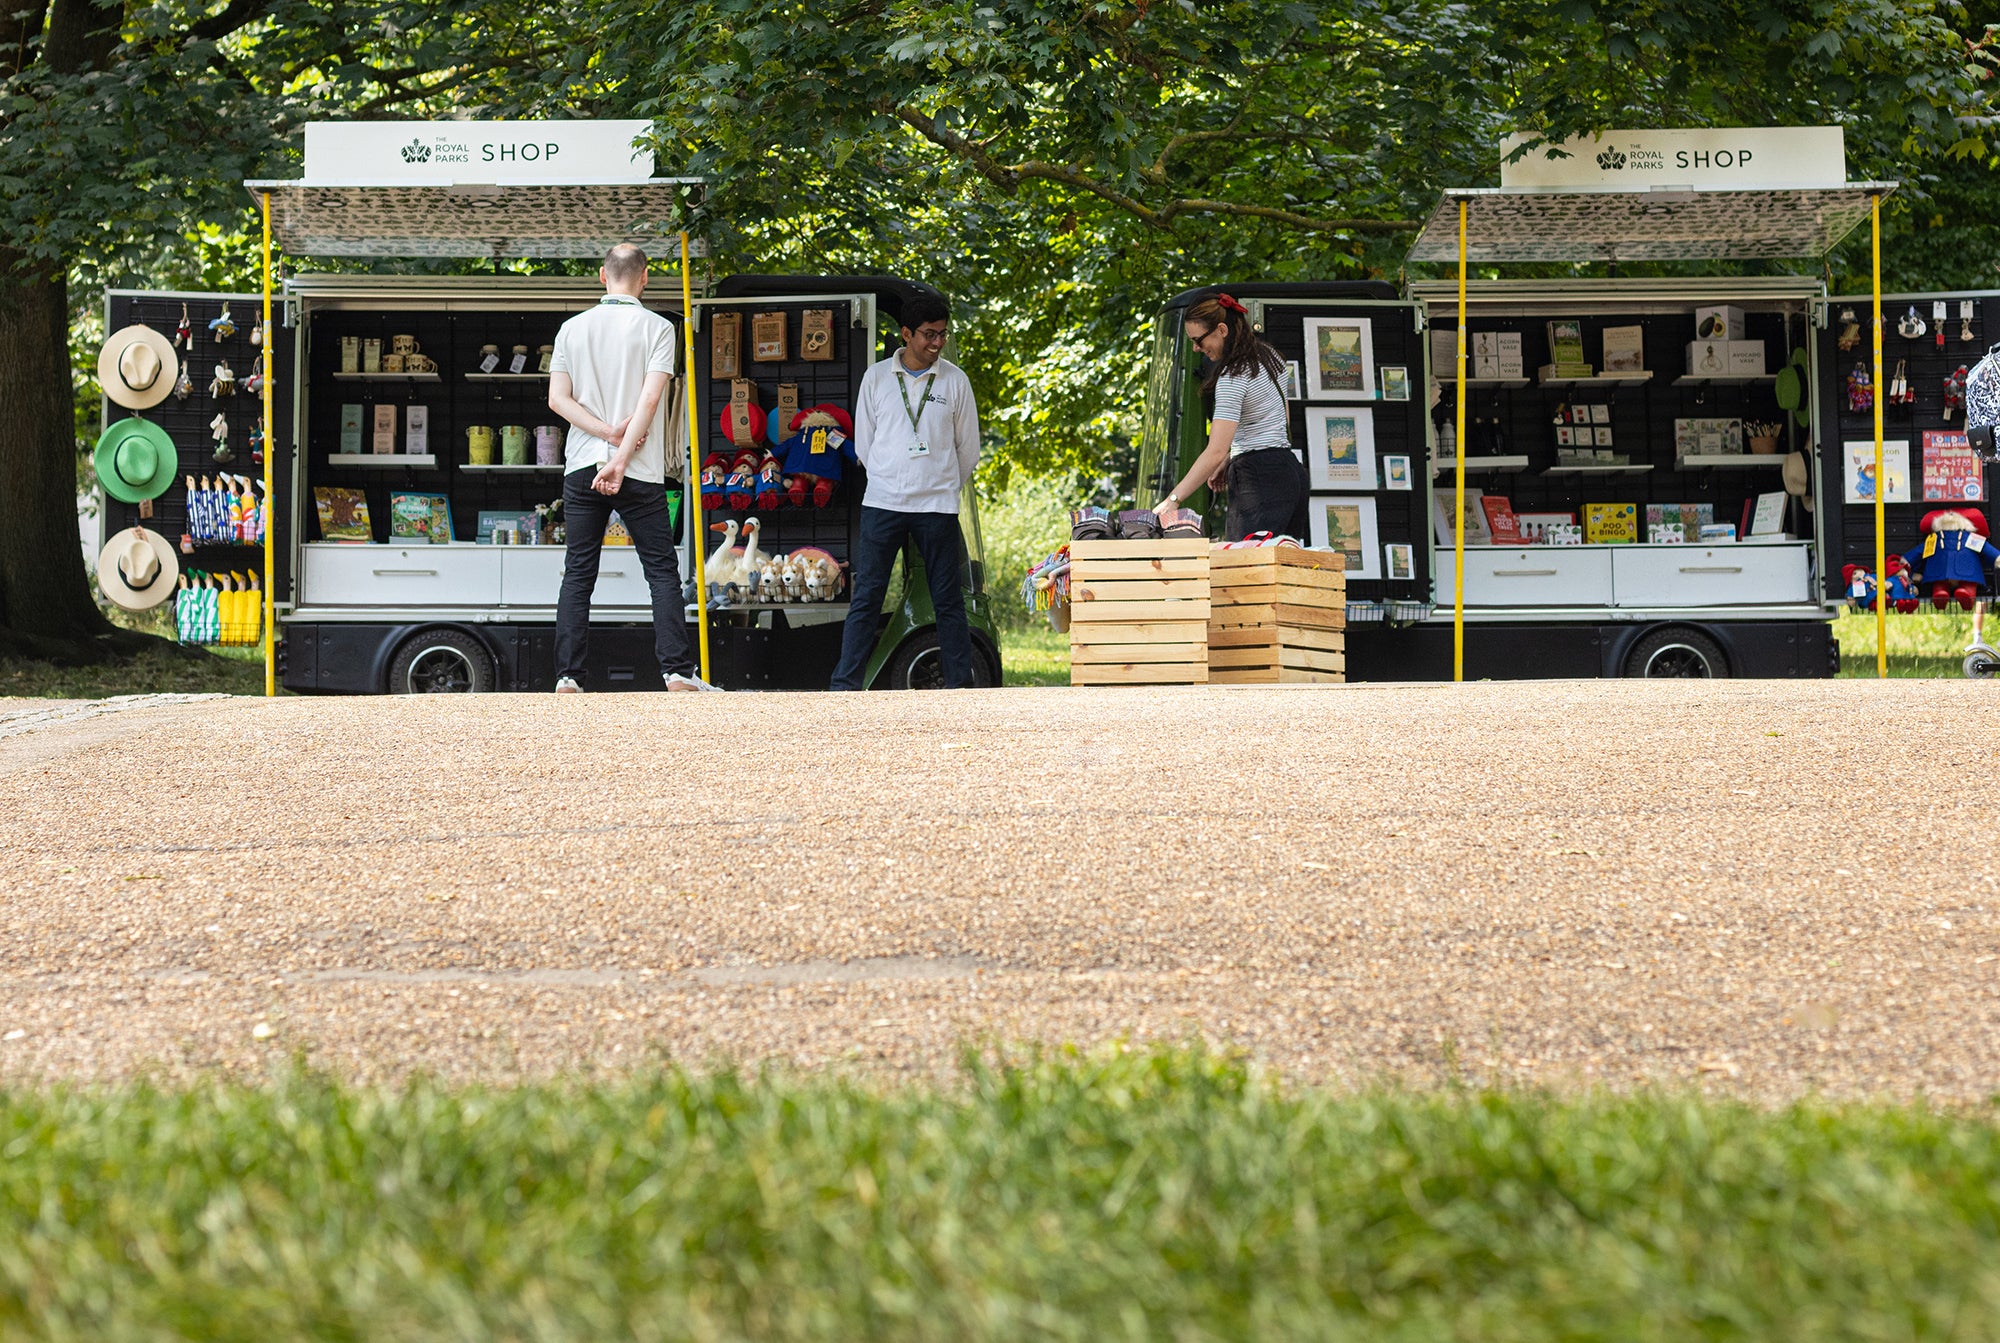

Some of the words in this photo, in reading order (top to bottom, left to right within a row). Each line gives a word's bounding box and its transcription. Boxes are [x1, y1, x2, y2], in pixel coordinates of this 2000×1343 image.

[435, 144, 470, 153] ROYAL
[481, 142, 560, 162] SHOP
[435, 154, 469, 163] PARKS
[1630, 151, 1664, 160] ROYAL
[1676, 149, 1753, 169] SHOP
[1630, 161, 1664, 170] PARKS
